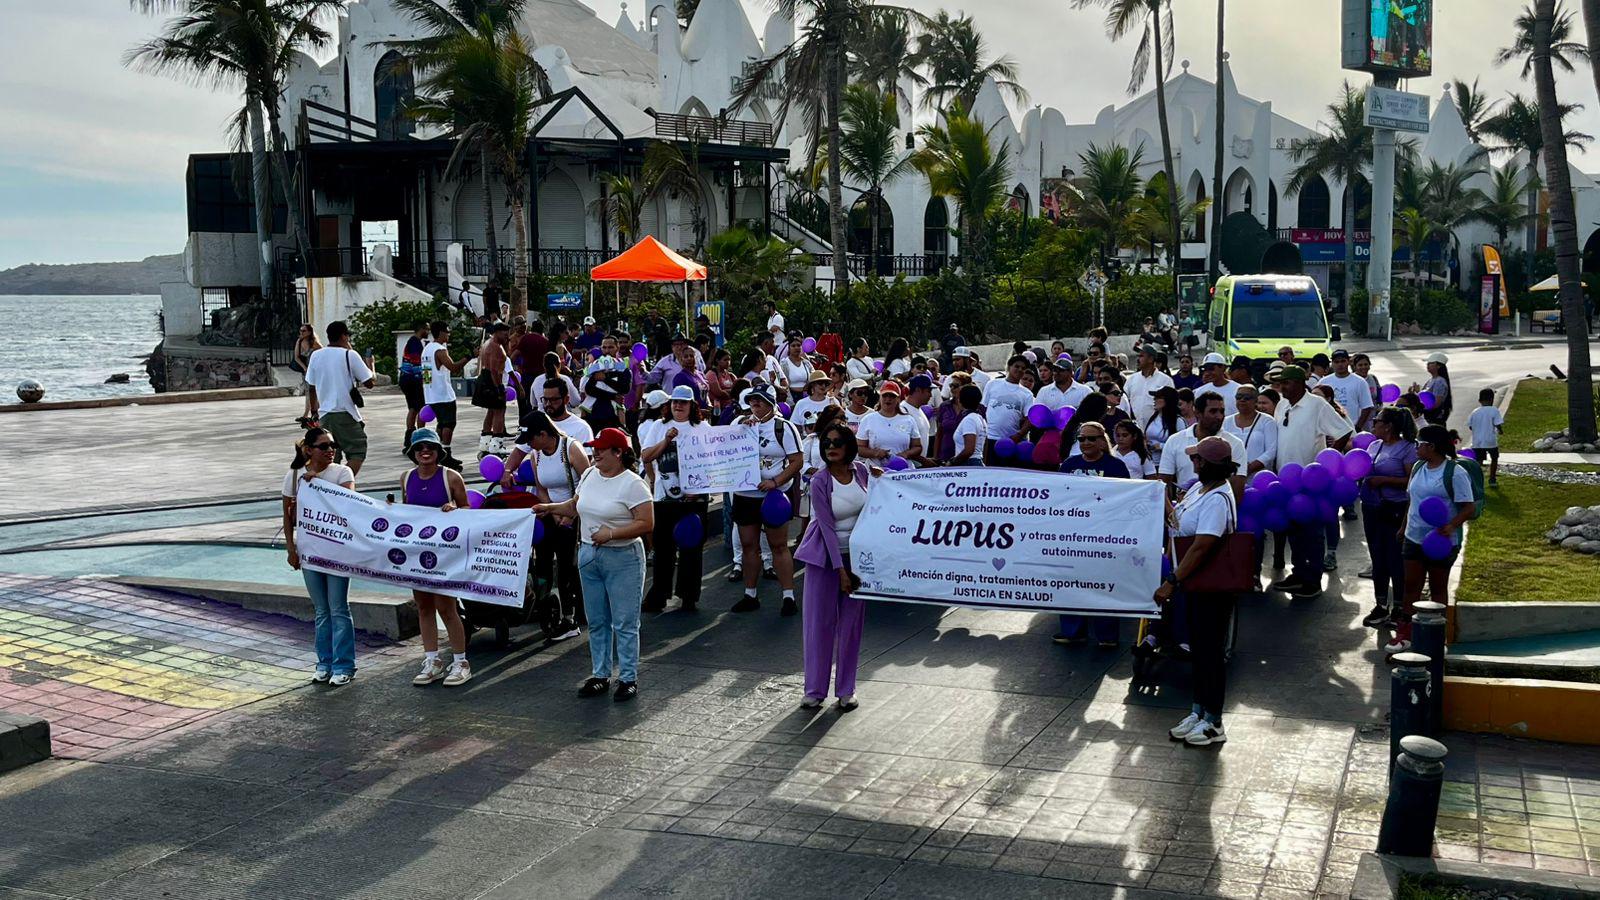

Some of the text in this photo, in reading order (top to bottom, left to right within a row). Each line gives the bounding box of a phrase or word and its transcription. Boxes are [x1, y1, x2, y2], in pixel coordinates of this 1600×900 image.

[945, 482, 1050, 500] Caminamos
[303, 507, 348, 528] EL LUPUS
[912, 503, 1090, 518] Por quienes luchamos todos los días
[298, 521, 354, 541] PUEDE AFECTAR
[492, 531, 517, 540] ACCESO
[888, 518, 1138, 550] Con LUPUS y otras enfermedades
[481, 540, 511, 548] DESIGUAL
[474, 547, 521, 558] TRATAMIENTOS
[1041, 547, 1117, 559] autoinmunes.
[483, 557, 518, 567] VIOLENCIA
[471, 565, 519, 577] INSTITUCIONAL
[898, 569, 1115, 593] ¡Atención digna, tratamientos oportunos y
[472, 584, 497, 595] SALVAR
[497, 589, 518, 598] VIDAS
[953, 587, 1053, 602] JUSTICIA EN SALUD!
